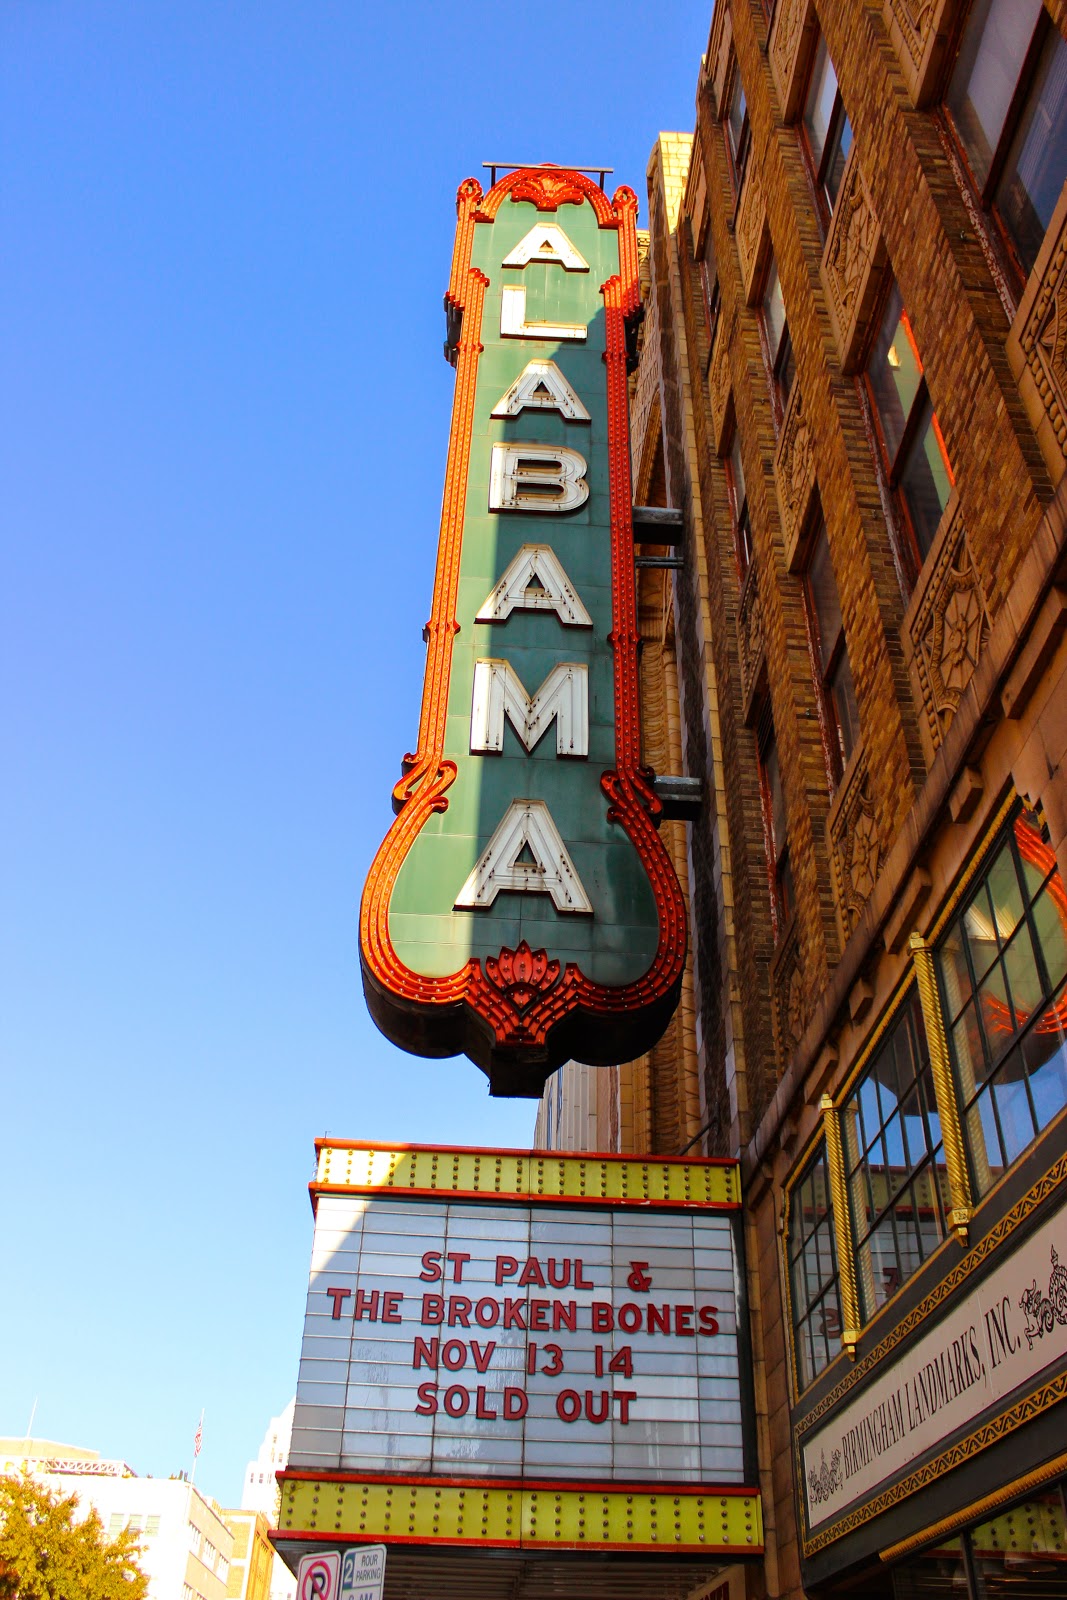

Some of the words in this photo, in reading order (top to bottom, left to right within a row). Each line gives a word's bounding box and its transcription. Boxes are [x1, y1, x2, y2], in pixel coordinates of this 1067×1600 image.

[452, 221, 596, 915] ALABAMA
[420, 1251, 471, 1284] ST
[495, 1255, 594, 1289] PAUL
[627, 1262, 653, 1292] &
[326, 1288, 404, 1323] THE
[420, 1293, 578, 1332] BROKEN
[591, 1303, 720, 1336] BONES
[413, 1337, 496, 1373] NOV
[528, 1343, 564, 1376] 13
[595, 1345, 634, 1379] 14
[415, 1382, 529, 1421] SOLD
[555, 1389, 637, 1425] OUT
[841, 1389, 906, 1479] BIRMINGHAM
[904, 1325, 987, 1432] LANDMARKS,
[984, 1296, 1021, 1369] INC.
[344, 1559, 353, 1583] 2
[356, 1568, 381, 1582] PARKING
[361, 1554, 378, 1567] HOUR
